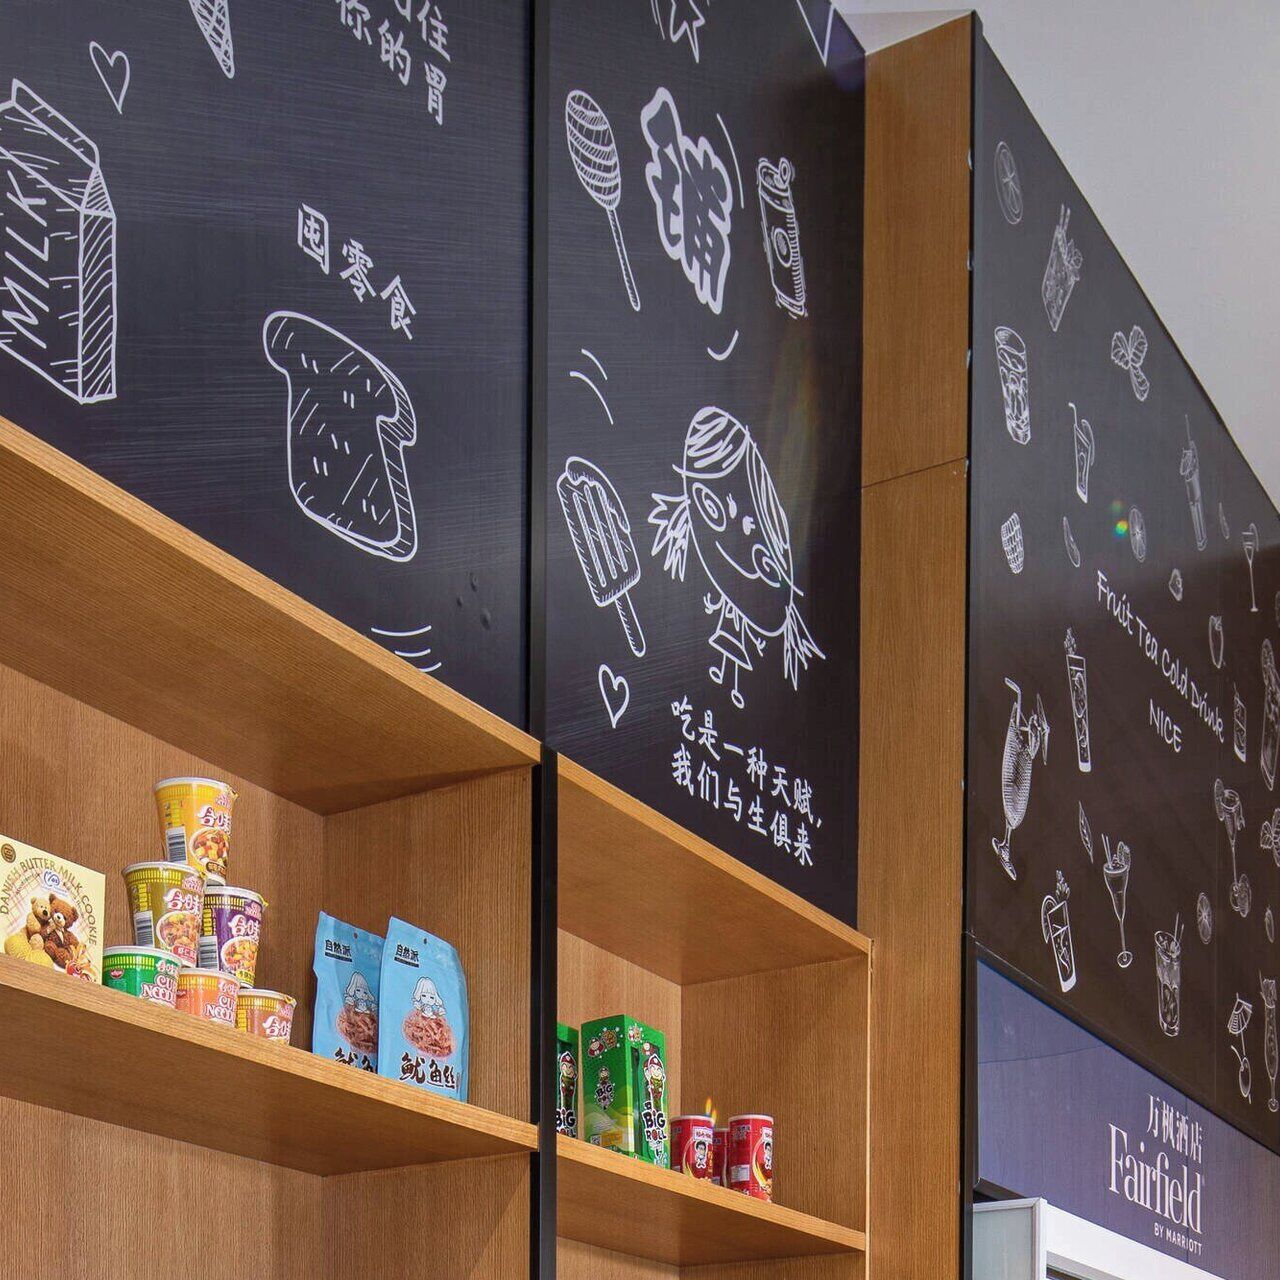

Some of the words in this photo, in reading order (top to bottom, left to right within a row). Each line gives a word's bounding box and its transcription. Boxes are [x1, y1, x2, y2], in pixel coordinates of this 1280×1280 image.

[394, 0, 451, 63] 住
[2, 170, 49, 349] MILK
[1096, 569, 1133, 636] Fruit
[1136, 619, 1160, 668] Tea
[1161, 648, 1188, 700] Cold
[1190, 682, 1224, 743] Drink
[1149, 699, 1183, 753] NICE
[672, 743, 813, 866] 我们与生俱来
[60, 865, 83, 892] MILK
[81, 895, 98, 946] COOKIE
[1146, 1093, 1203, 1164] 万枫酒店
[1108, 1122, 1203, 1235] Fairfield
[1154, 1222, 1164, 1239] BY
[1166, 1229, 1203, 1256] MARRIOTT
